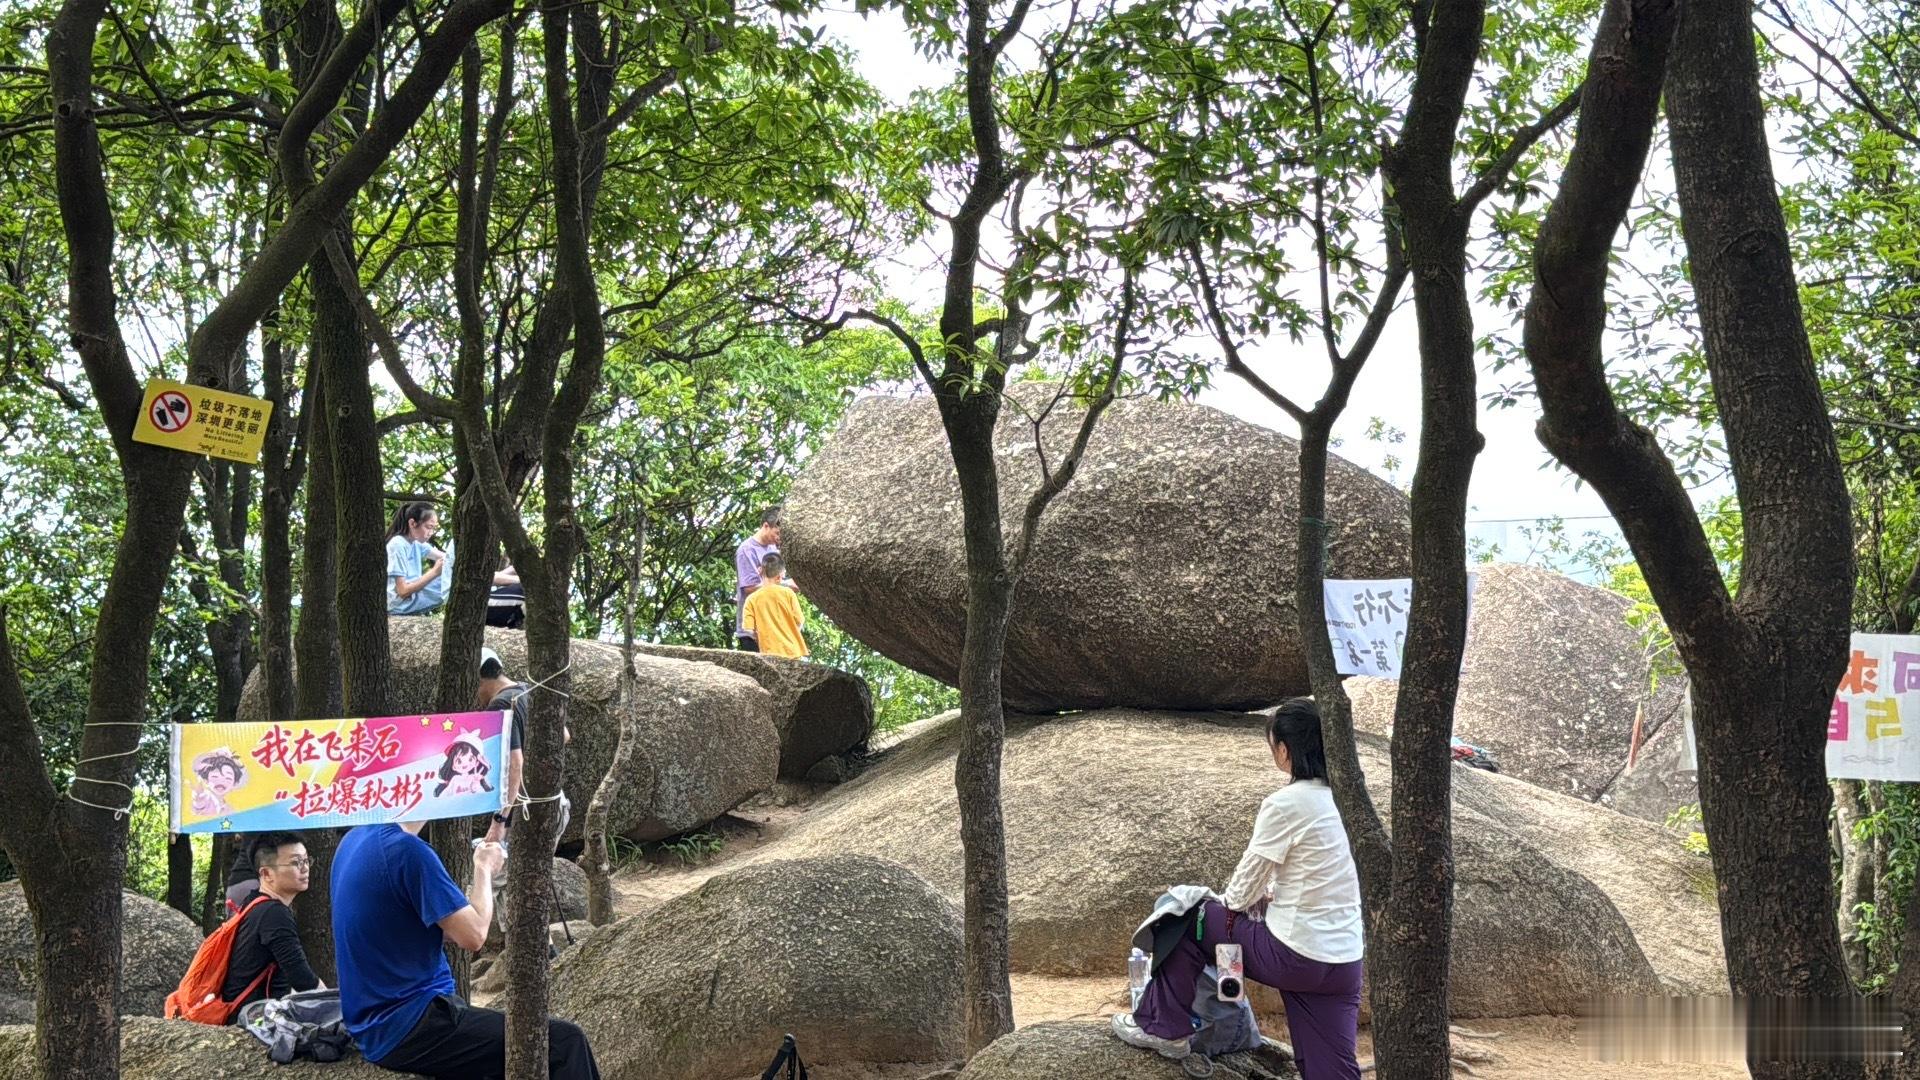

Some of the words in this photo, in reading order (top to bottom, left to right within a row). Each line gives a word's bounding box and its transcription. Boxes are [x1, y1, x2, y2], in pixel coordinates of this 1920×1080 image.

[199, 398, 262, 422] 垃圾不落地
[195, 412, 259, 435] 深圳更美丽
[251, 723, 401, 778] 我在飞来石
